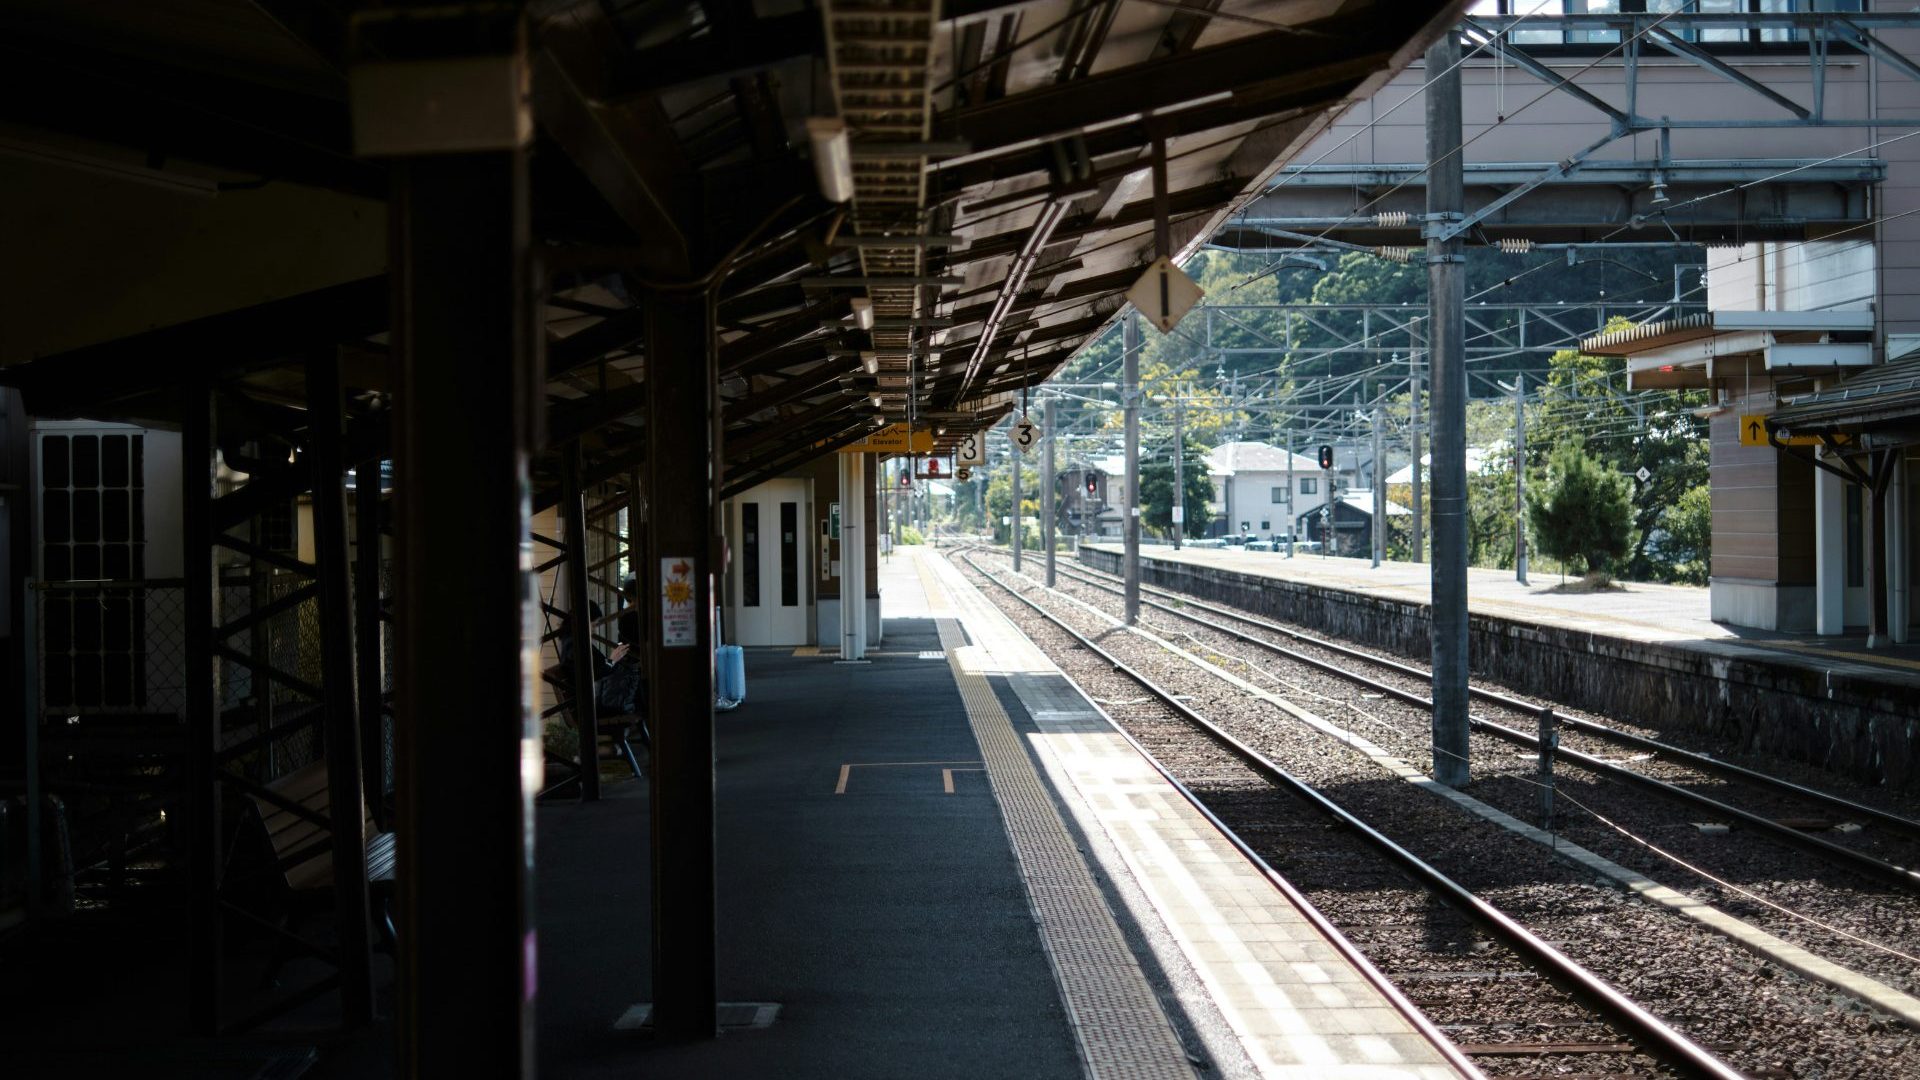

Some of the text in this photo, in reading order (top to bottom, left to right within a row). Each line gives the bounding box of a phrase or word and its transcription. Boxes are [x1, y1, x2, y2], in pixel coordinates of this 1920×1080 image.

[1018, 424, 1032, 445] 3
[963, 437, 976, 460] 3
[959, 468, 969, 480] 5
